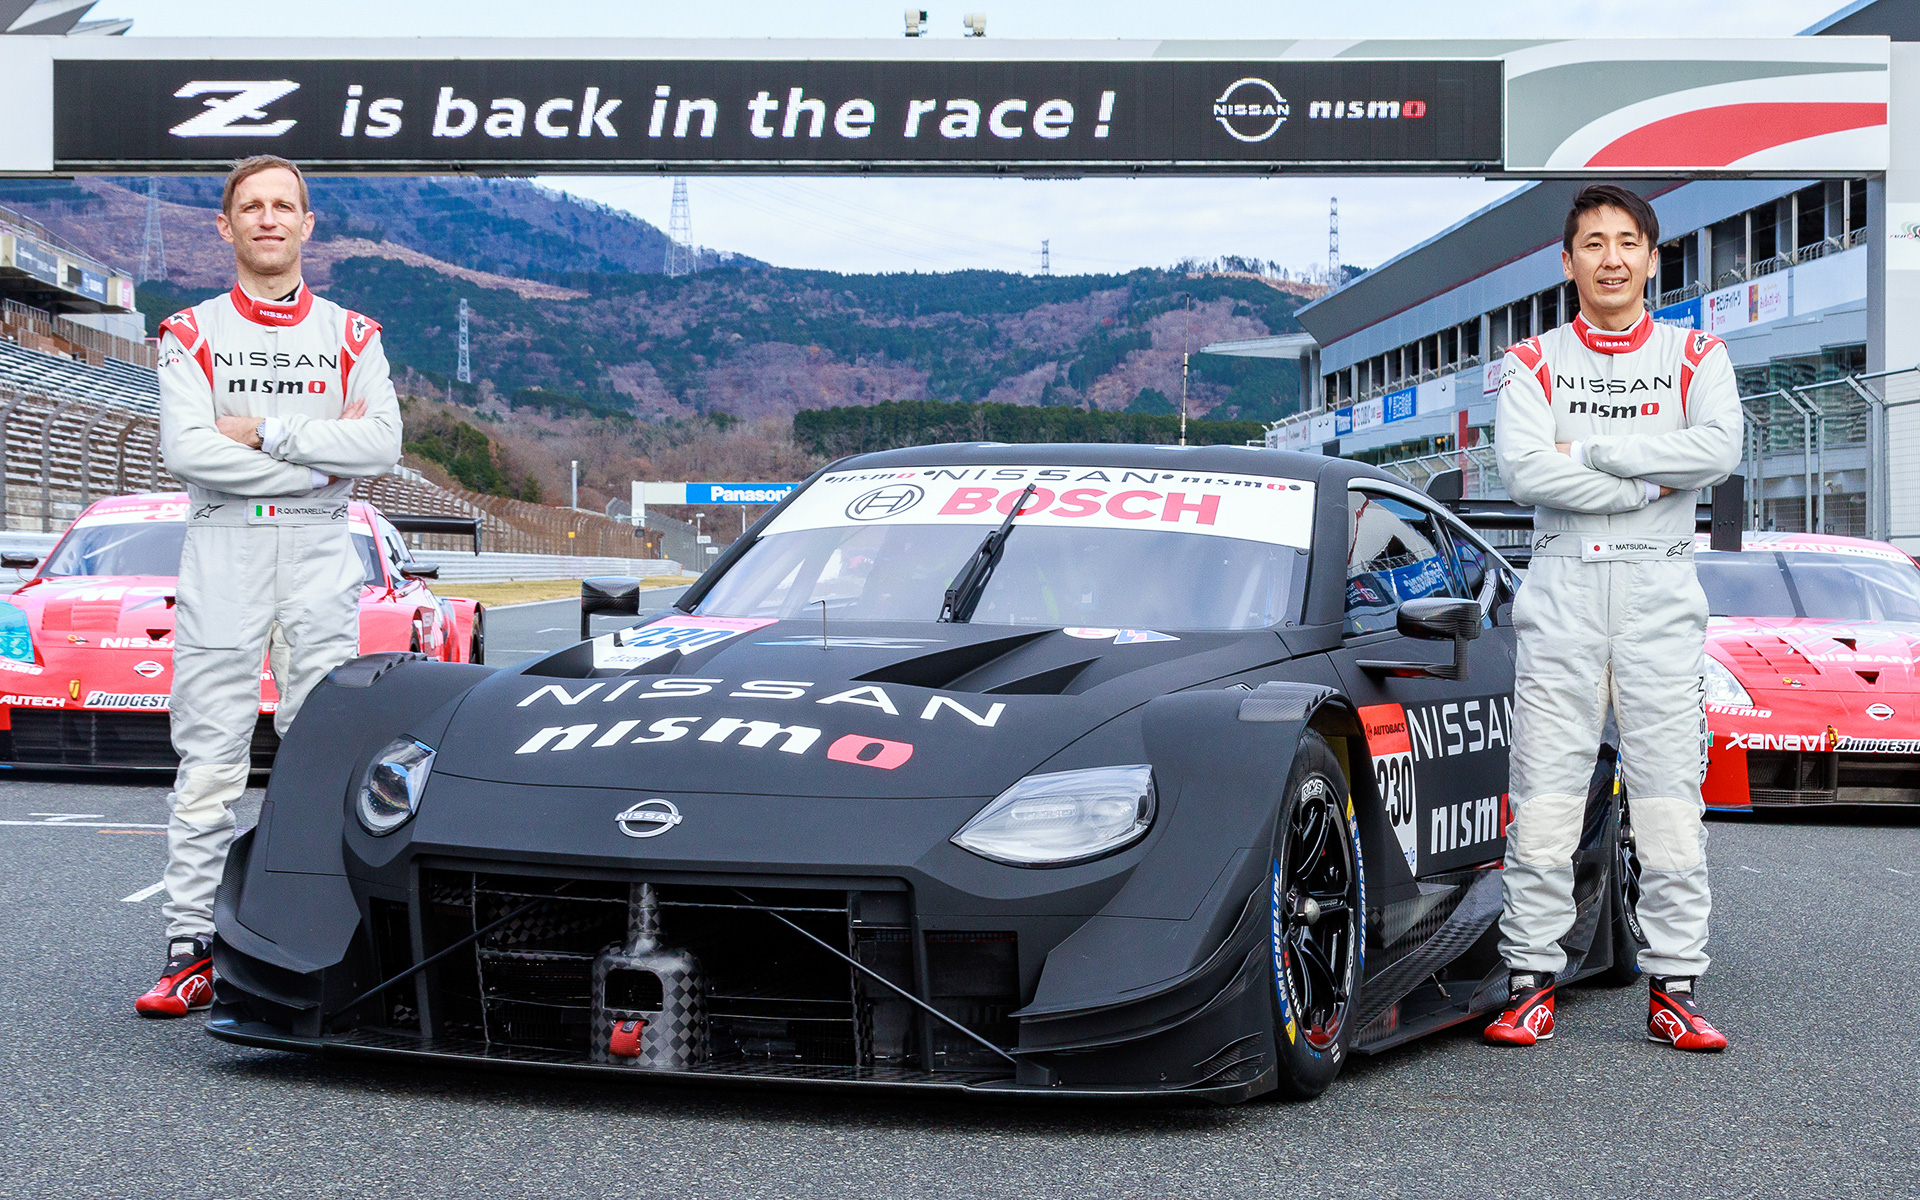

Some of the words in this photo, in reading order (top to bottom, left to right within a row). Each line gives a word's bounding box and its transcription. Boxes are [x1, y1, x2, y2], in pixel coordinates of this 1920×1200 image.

[340, 85, 403, 138] is
[432, 87, 623, 138] back
[648, 85, 718, 138] in
[748, 88, 876, 138] the
[904, 98, 1074, 139] race
[1213, 104, 1290, 116] NISSAN
[1309, 101, 1427, 119] nismo
[259, 309, 293, 320] NISSAN
[214, 352, 337, 369] NISSAN
[228, 379, 326, 394] nismo
[1556, 375, 1672, 394] NISSAN
[1569, 401, 1660, 419] nismo
[832, 473, 916, 484] nismo
[931, 469, 1159, 484] NISSAN
[1181, 476, 1286, 491] nismo
[937, 487, 1221, 526] BOSCH
[1806, 654, 1913, 664] NISSAN
[0, 695, 66, 707] AUTECH
[86, 693, 171, 707] BRIDGEST
[516, 678, 1007, 727] NISSAN
[1709, 704, 1773, 718] nismo
[1373, 722, 1405, 736] AUTOBACS
[514, 716, 914, 770] nismo
[1376, 755, 1413, 828] 230
[618, 812, 681, 824] NISSAN
[1354, 837, 1367, 958] MICHELIN
[1273, 872, 1287, 1002] MICHELIN
[1284, 951, 1302, 1018] nismo
